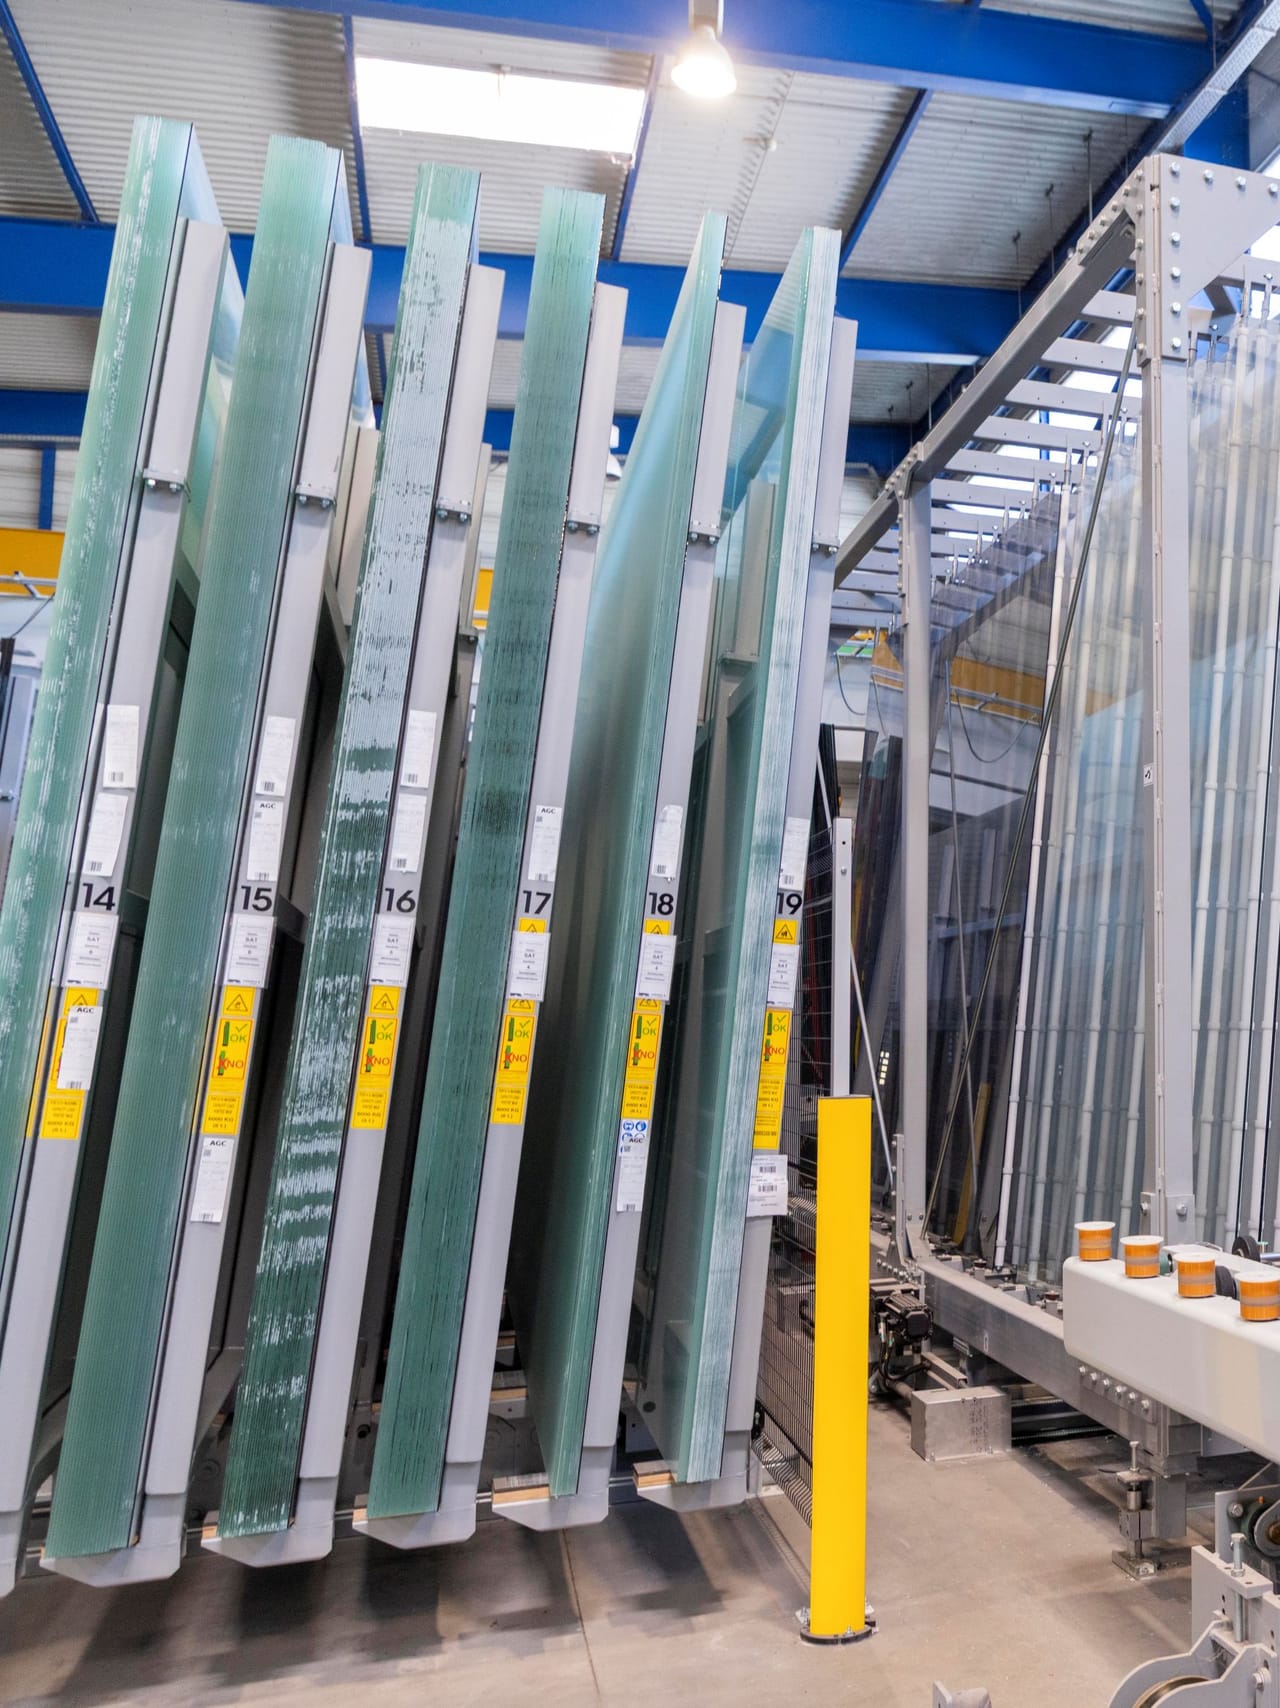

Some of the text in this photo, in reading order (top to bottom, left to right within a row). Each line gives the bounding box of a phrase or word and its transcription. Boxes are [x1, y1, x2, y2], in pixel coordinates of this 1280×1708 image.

[259, 802, 276, 810] AGC
[82, 882, 115, 911] 14
[241, 885, 273, 912] 15
[384, 888, 416, 913] 16
[523, 890, 552, 914] 17
[648, 892, 674, 915] 18
[777, 892, 802, 915] 19
[643, 1027, 656, 1036] OK
[772, 1024, 786, 1032] OK
[230, 1033, 247, 1043] OK
[376, 1031, 393, 1041] OK
[514, 1030, 530, 1038] OK
[640, 1050, 655, 1059] NO
[771, 1047, 785, 1055] NO
[373, 1056, 390, 1066] NO
[512, 1054, 528, 1062] NO
[226, 1059, 244, 1069] NO
